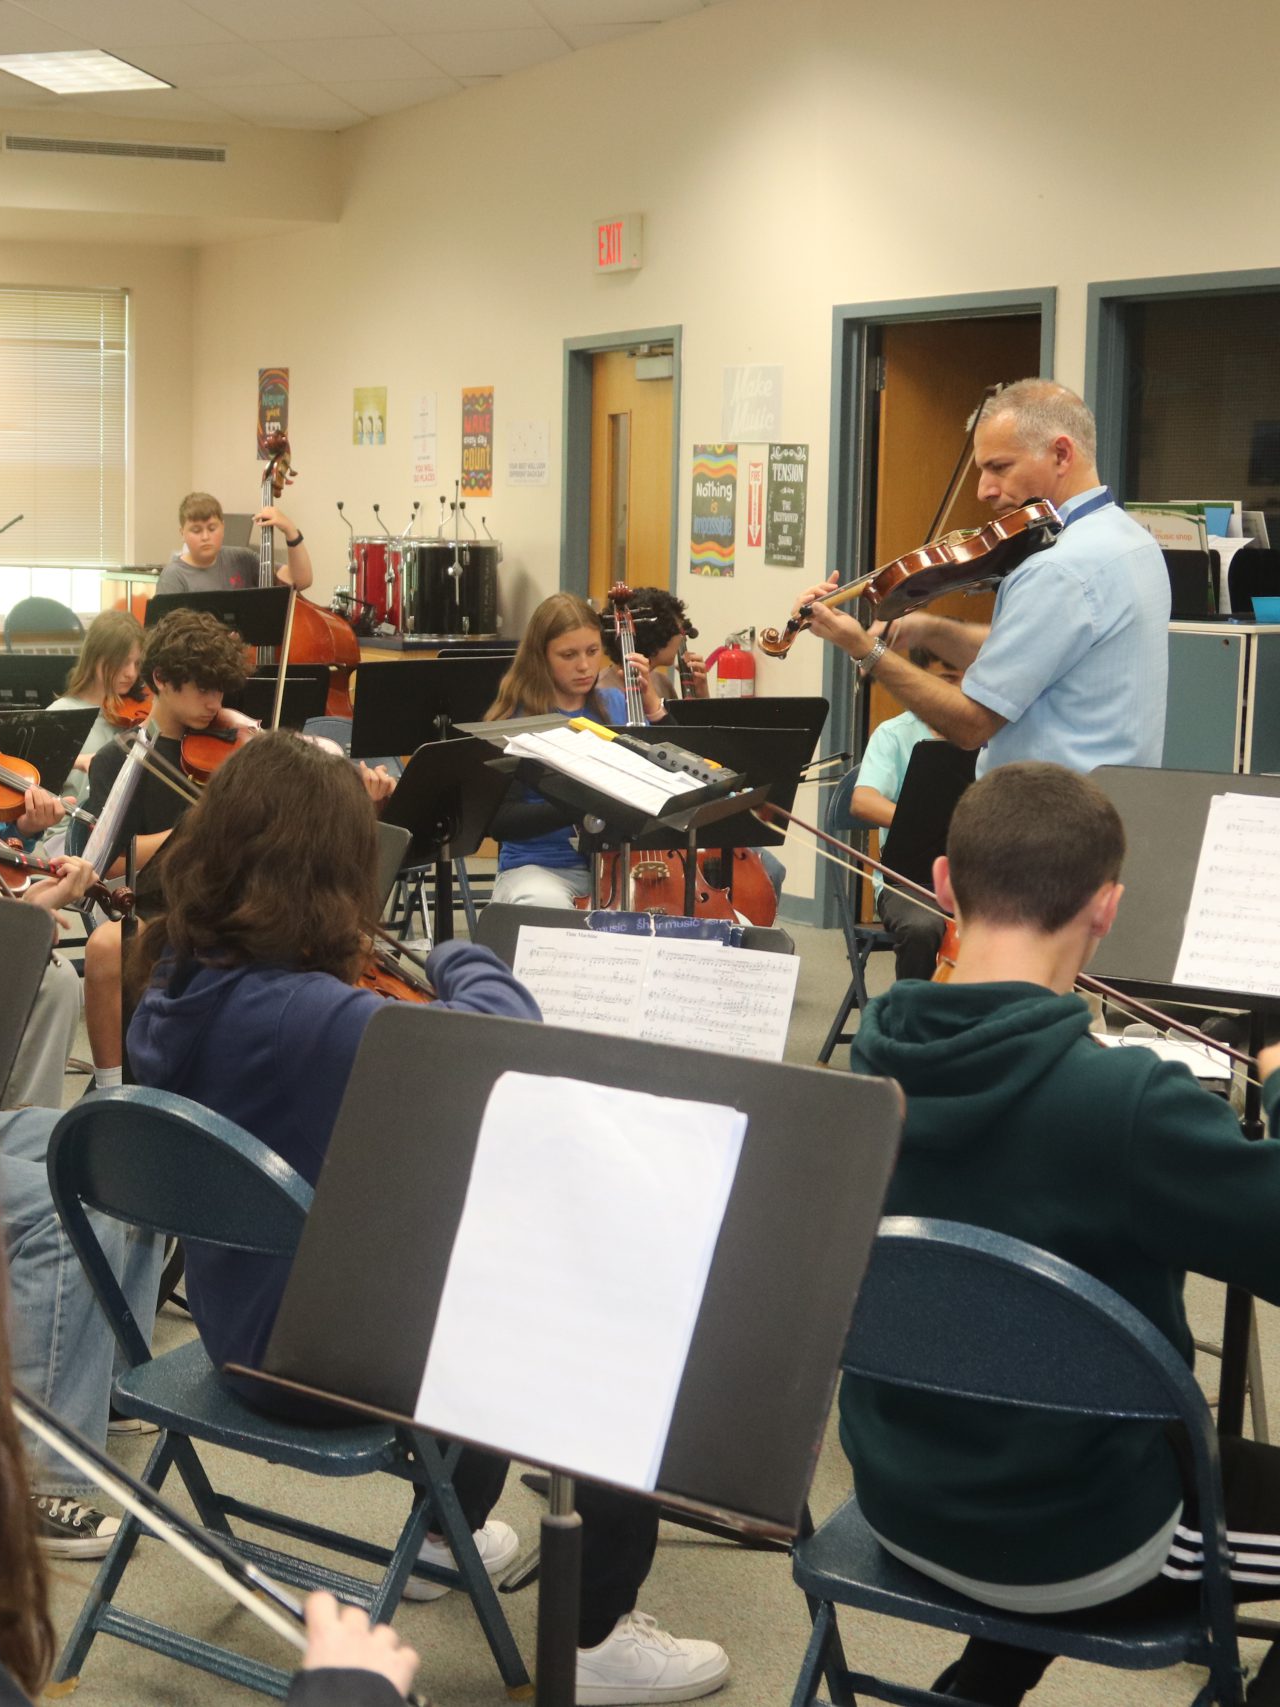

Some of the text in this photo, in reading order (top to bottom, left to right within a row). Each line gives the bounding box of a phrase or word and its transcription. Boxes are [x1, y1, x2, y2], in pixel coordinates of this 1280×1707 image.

[598, 222, 624, 267] EXIT
[730, 367, 773, 406] Make
[463, 415, 491, 433] MAKE
[729, 401, 775, 438] Music
[751, 470, 761, 481] FIRE
[772, 463, 804, 482] TENSION
[696, 481, 733, 502] Nothing
[710, 499, 719, 514] is
[693, 514, 732, 538] impossible
[665, 918, 701, 929] music
